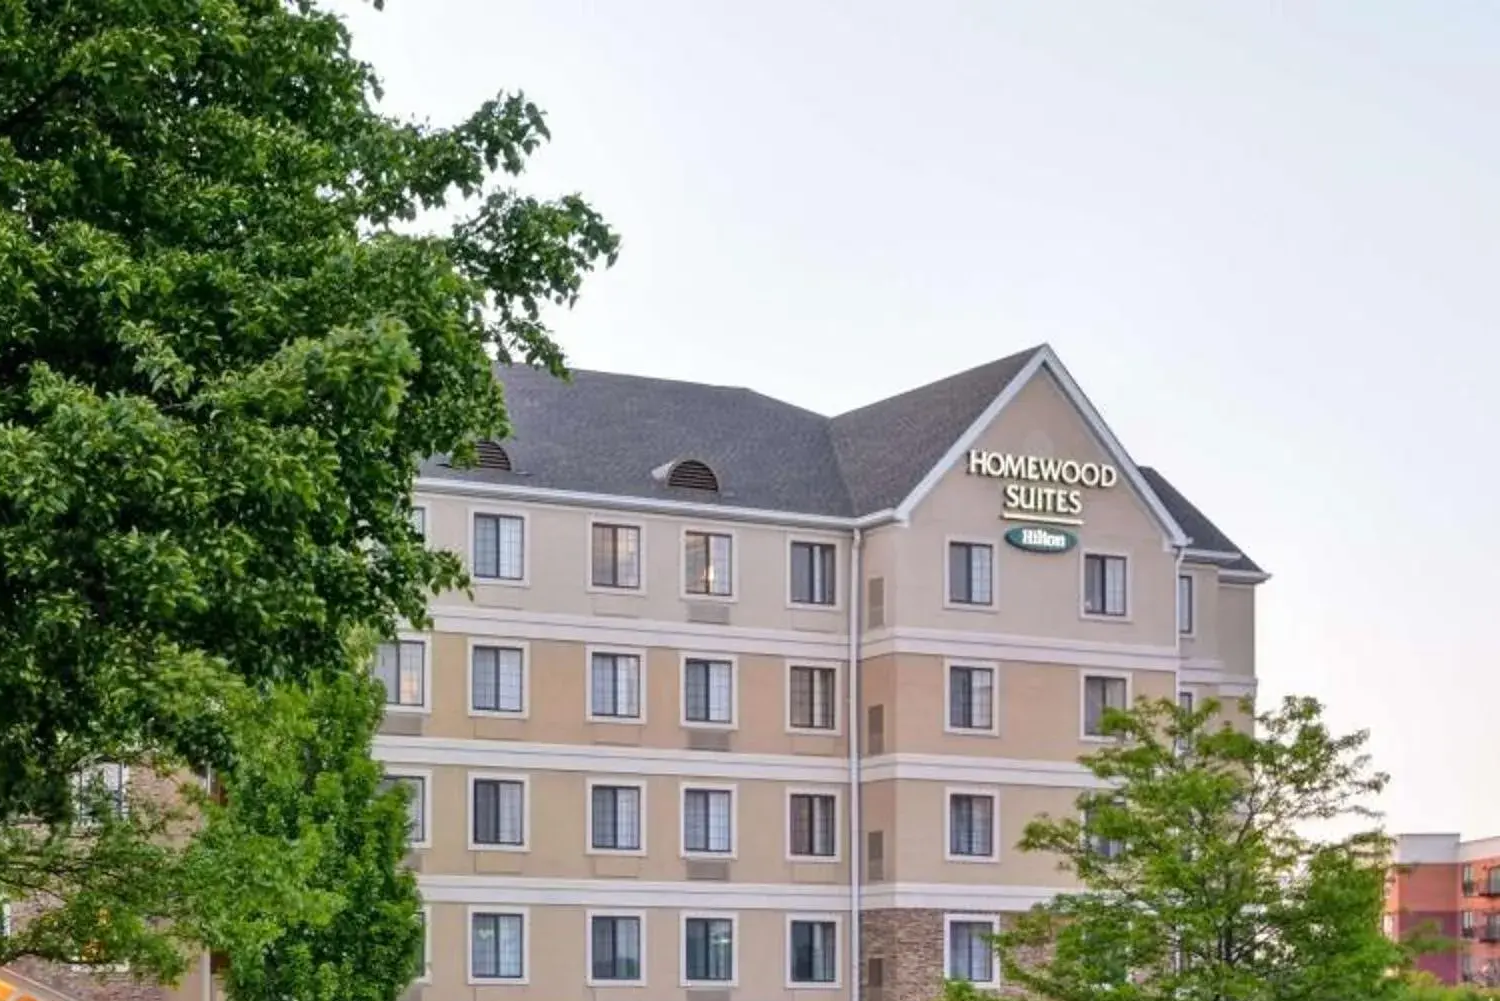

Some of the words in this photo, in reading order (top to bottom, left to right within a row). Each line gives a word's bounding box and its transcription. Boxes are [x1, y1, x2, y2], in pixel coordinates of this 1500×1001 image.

[969, 448, 1117, 487] HOMEWOOD
[1006, 484, 1083, 514] SUITES
[1021, 528, 1066, 548] Hilton
